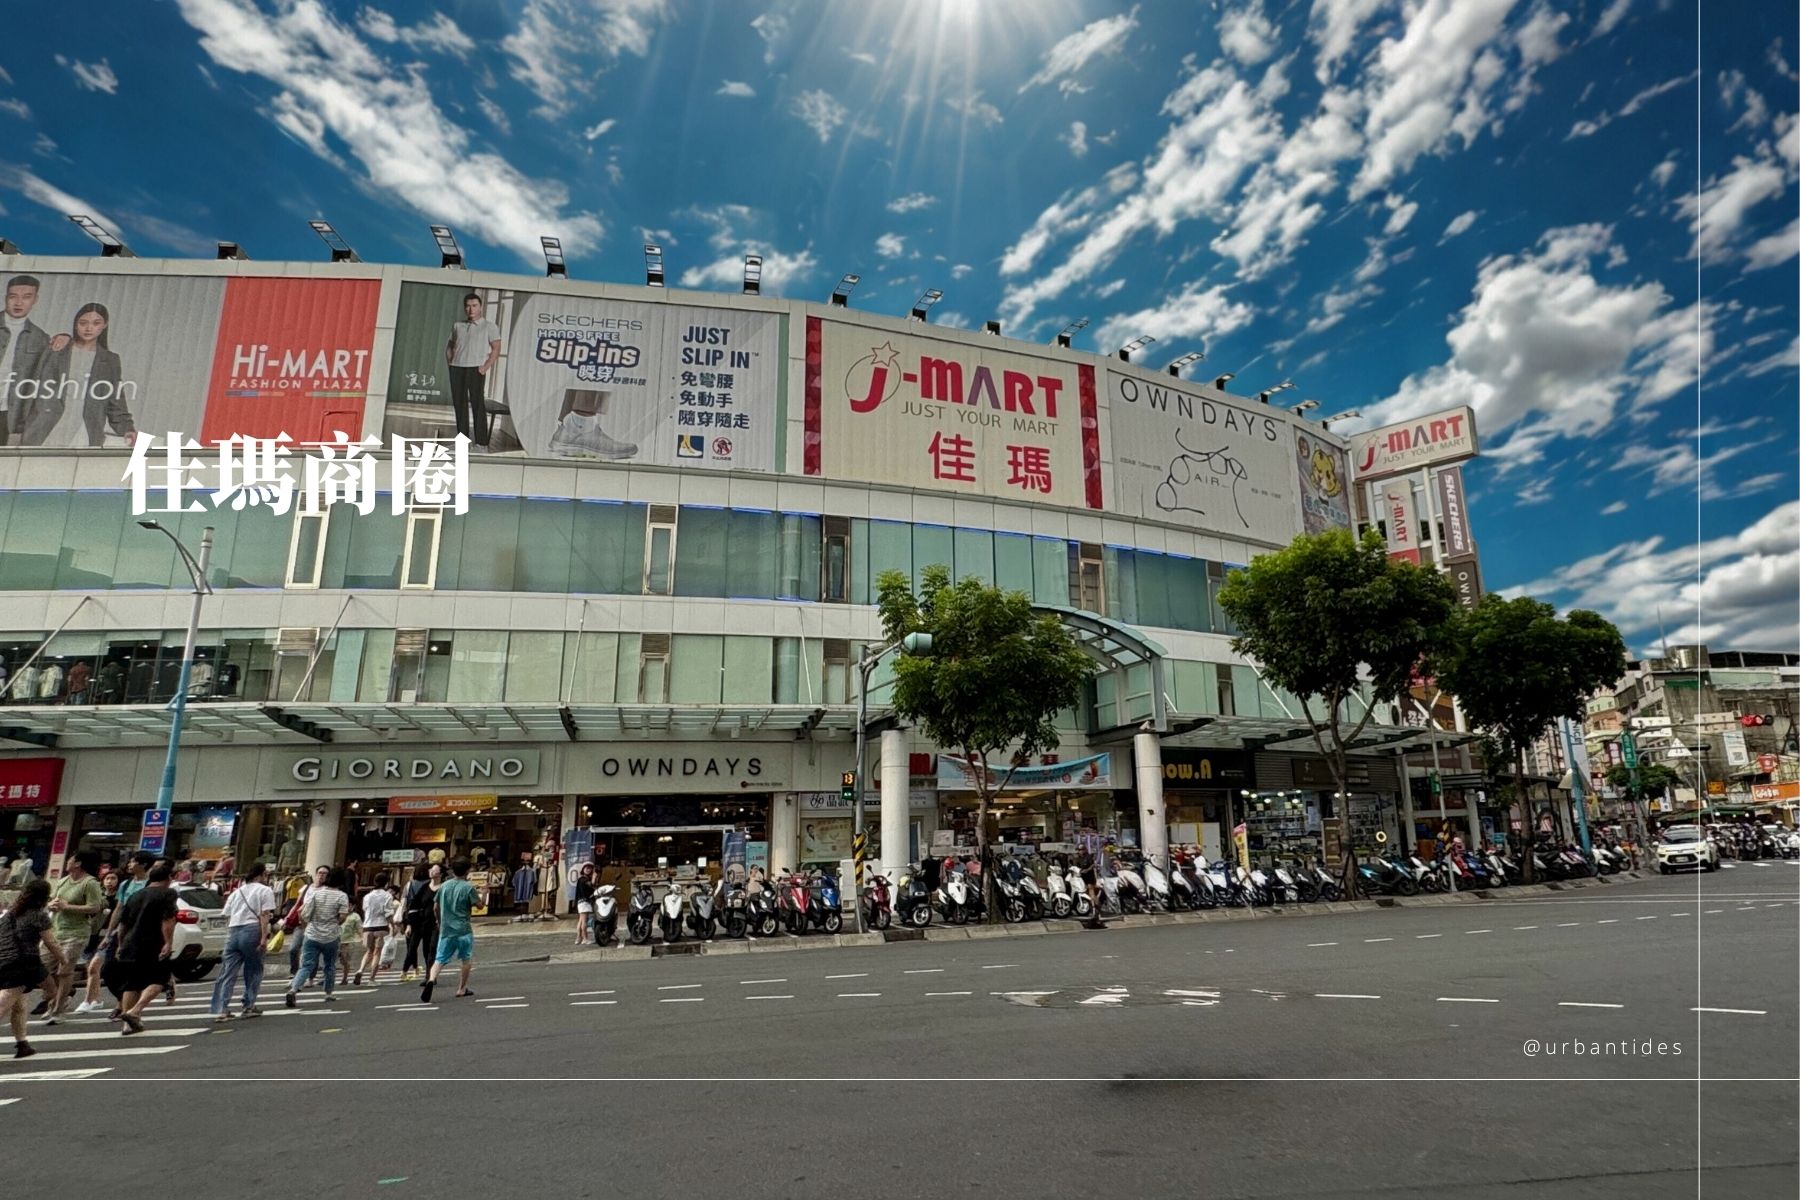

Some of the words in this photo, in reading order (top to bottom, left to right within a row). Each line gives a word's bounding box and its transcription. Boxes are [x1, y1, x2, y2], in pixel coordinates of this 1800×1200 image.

[538, 313, 643, 331] SKECHERS
[537, 328, 584, 340] HANDS
[586, 331, 620, 342] FREE
[683, 326, 730, 346] JUST
[232, 344, 369, 379] Hi-MART
[538, 338, 639, 367] Slip-ins
[681, 347, 724, 367] SLIP
[0, 372, 138, 401] fashion
[230, 379, 301, 389] FASHION
[313, 380, 362, 389] PLAZA
[681, 371, 734, 390] 免彎腰
[679, 390, 734, 408] 免動手
[1120, 378, 1277, 441] OWNDAYS
[678, 410, 750, 429] 隨穿隨走
[901, 401, 947, 419] JUST
[957, 410, 1001, 428] YOUR
[1013, 418, 1059, 437] MART
[1383, 454, 1405, 464] JUST
[1411, 445, 1435, 456] YOUR
[1440, 438, 1465, 449] MART
[928, 431, 1052, 494] 佳瑪
[1444, 474, 1464, 550] SKECHERS
[292, 758, 524, 781] GIORDANO
[602, 758, 762, 777] OWNDAYS
